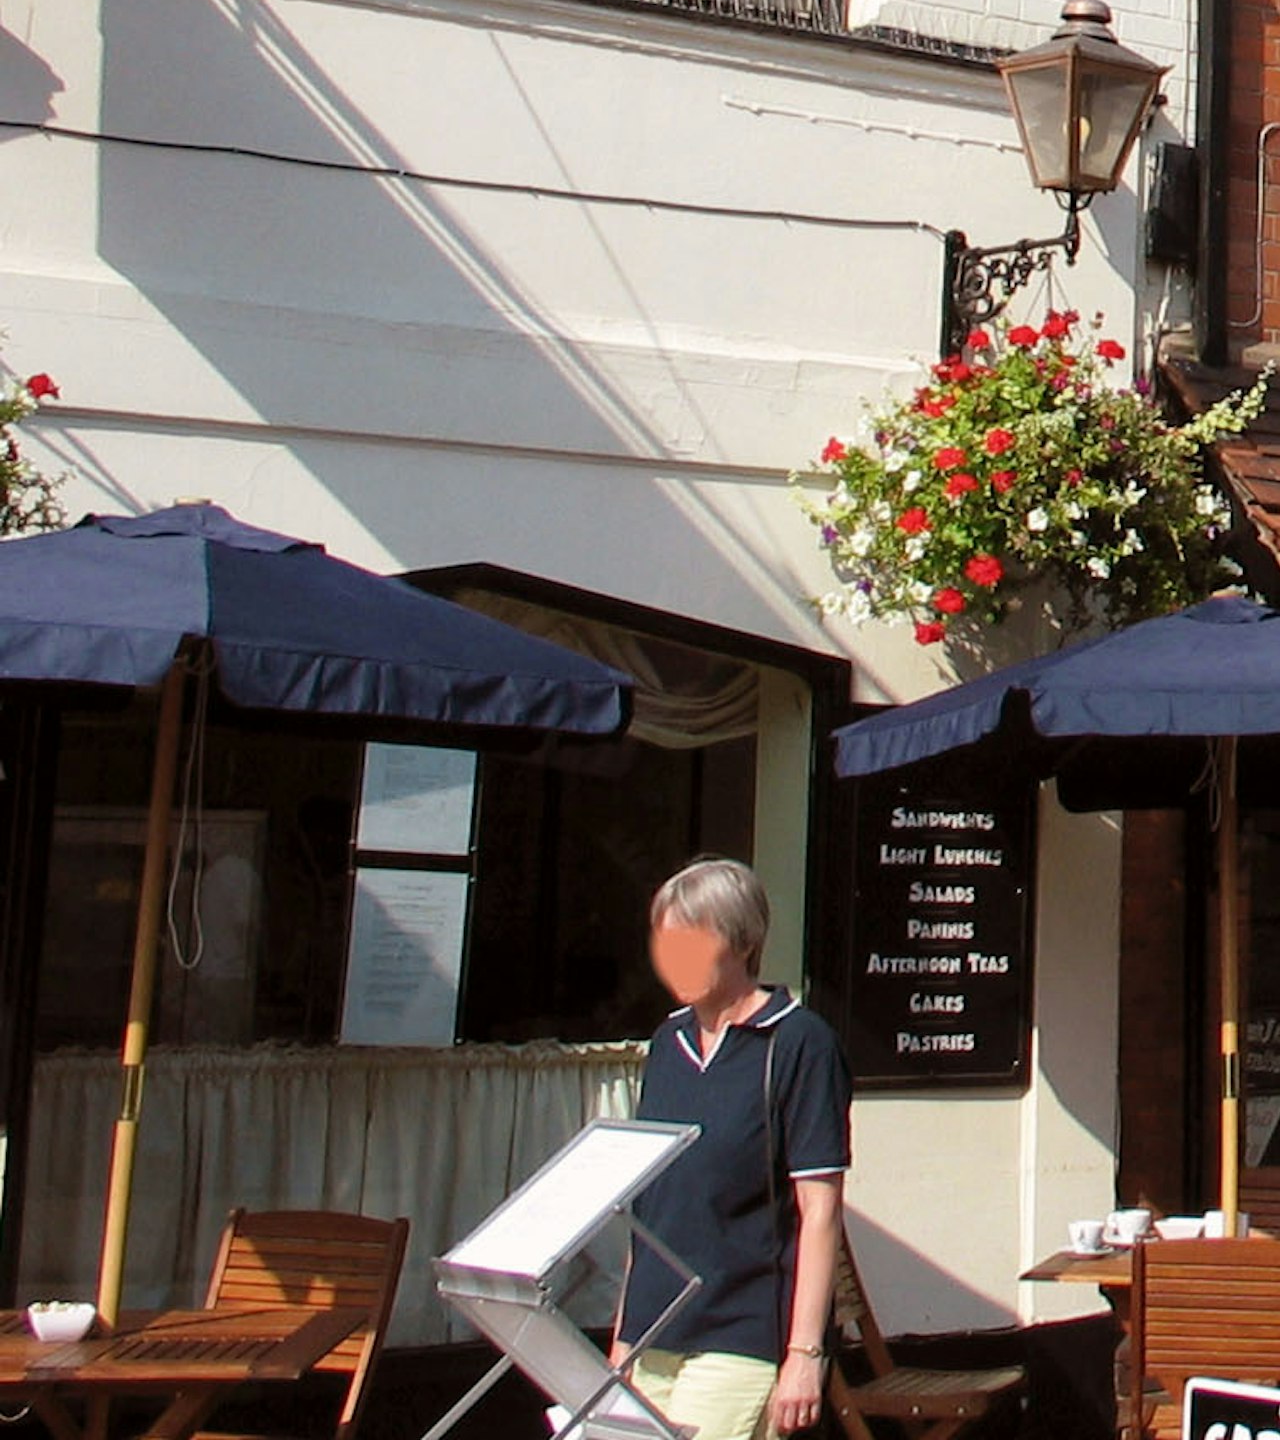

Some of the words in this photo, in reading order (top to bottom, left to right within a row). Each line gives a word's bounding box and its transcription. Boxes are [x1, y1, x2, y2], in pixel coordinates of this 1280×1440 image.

[880, 844, 928, 865] LIGHT
[934, 845, 1002, 867] LUNCHES
[909, 882, 976, 904] SALADS
[907, 919, 975, 940] PANINIS
[866, 953, 961, 975] AFTERNOON
[967, 952, 1009, 973] TEAS
[909, 993, 965, 1013] CAKES
[897, 1032, 975, 1053] PASTRIES
